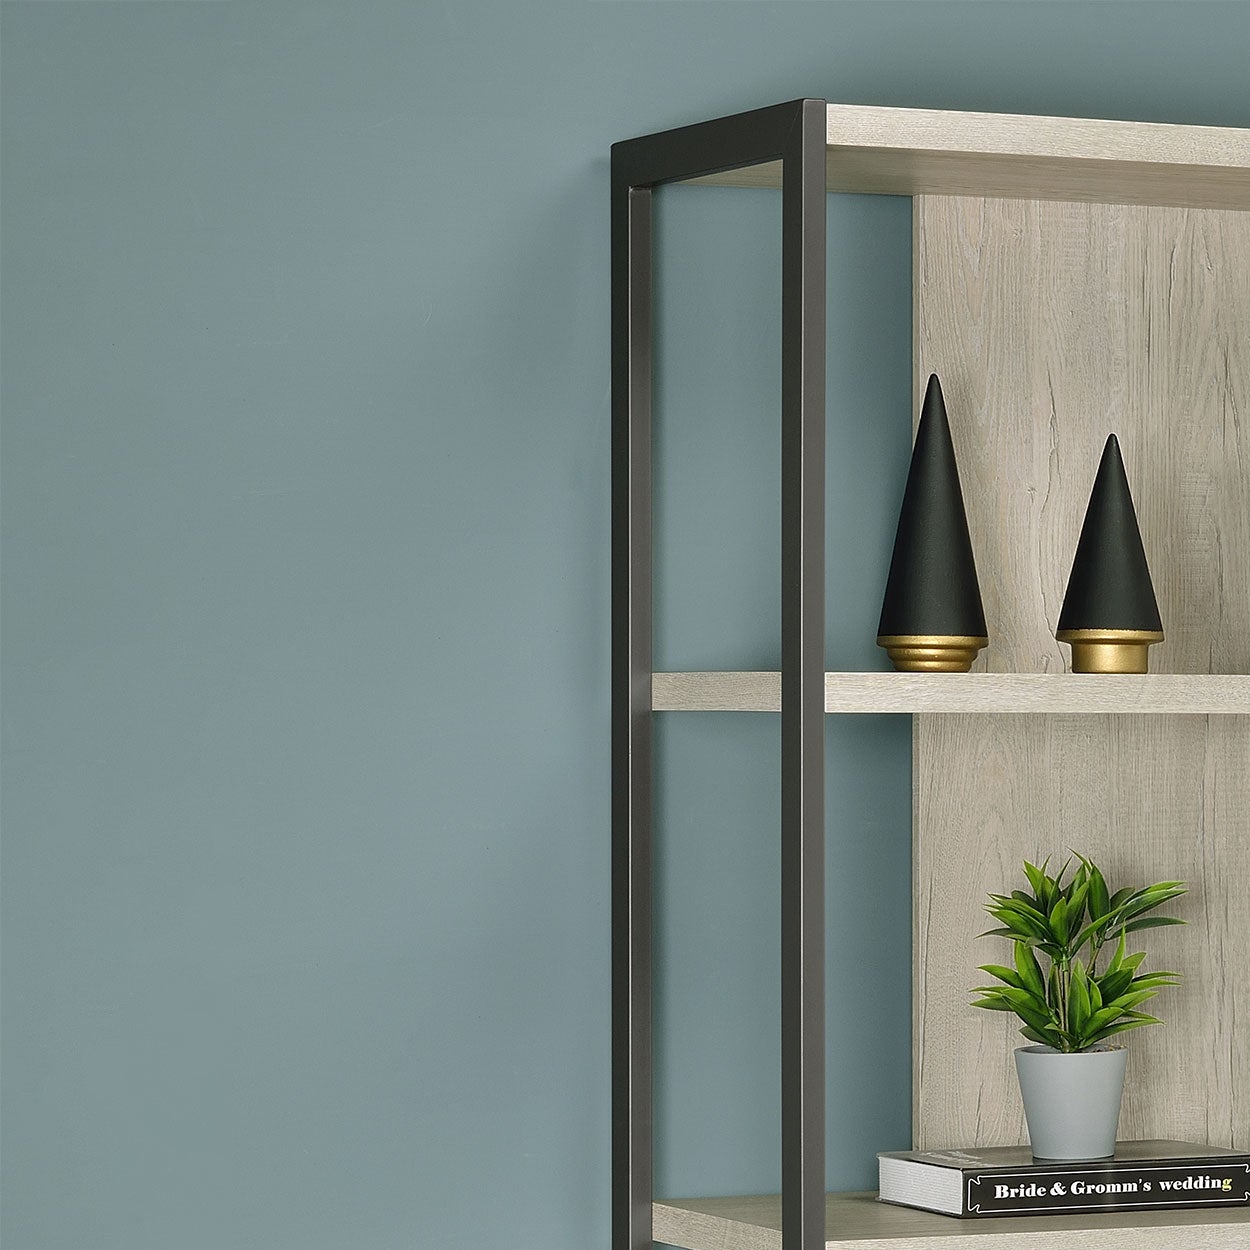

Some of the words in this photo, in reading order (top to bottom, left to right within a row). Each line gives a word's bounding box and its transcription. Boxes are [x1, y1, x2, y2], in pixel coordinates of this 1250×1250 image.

[994, 1182, 1046, 1199] Bride
[1050, 1182, 1068, 1196] &
[1070, 1178, 1152, 1196] Gromm's
[1159, 1176, 1232, 1192] wedding
